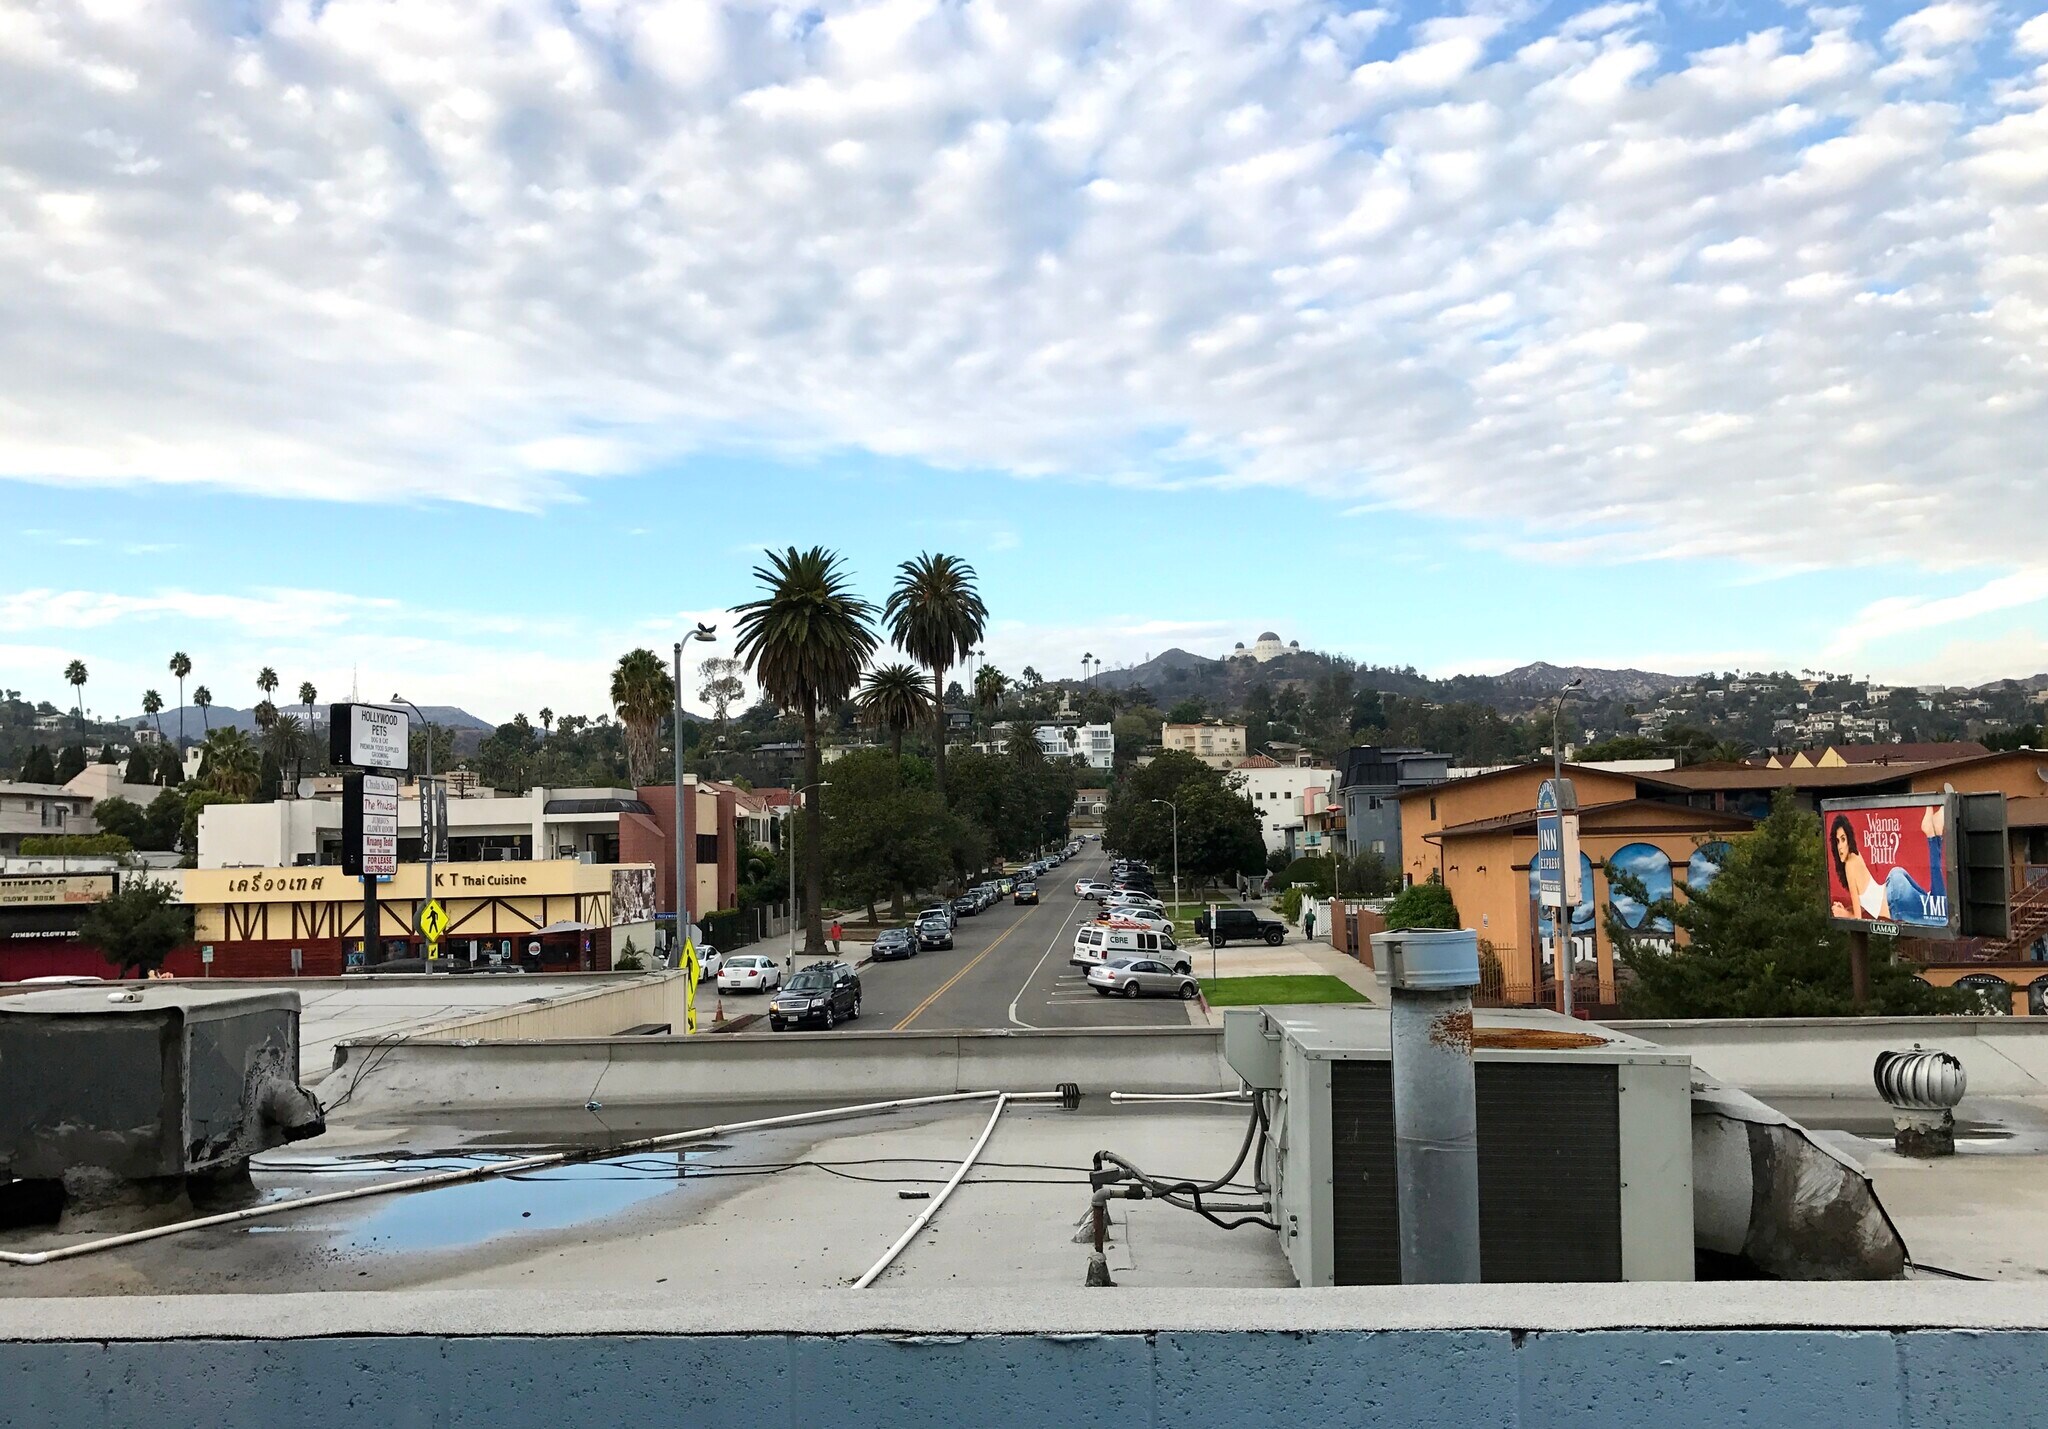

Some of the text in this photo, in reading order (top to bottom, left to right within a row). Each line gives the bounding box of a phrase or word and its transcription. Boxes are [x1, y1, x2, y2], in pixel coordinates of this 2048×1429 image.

[277, 711, 321, 720] LLYWOOD
[361, 710, 397, 725] HOLLYWOOD
[372, 725, 387, 736] PETS
[371, 751, 389, 759] GROOMING
[365, 798, 375, 810] The
[1866, 813, 1900, 832] Wanna
[367, 836, 393, 848] Kruang Tedd
[1541, 829, 1557, 851] INN
[1863, 830, 1888, 848] Betta
[1871, 832, 1900, 865] Butt?
[367, 856, 392, 865] FOR LEASE
[1540, 857, 1560, 870] EXPRESS
[435, 873, 527, 887] K T Thai Cuisine
[1920, 890, 1946, 916] YMI
[41, 930, 65, 938] CLOWN
[1872, 923, 1897, 934] LAMAR
[1110, 936, 1129, 944] CBRE
